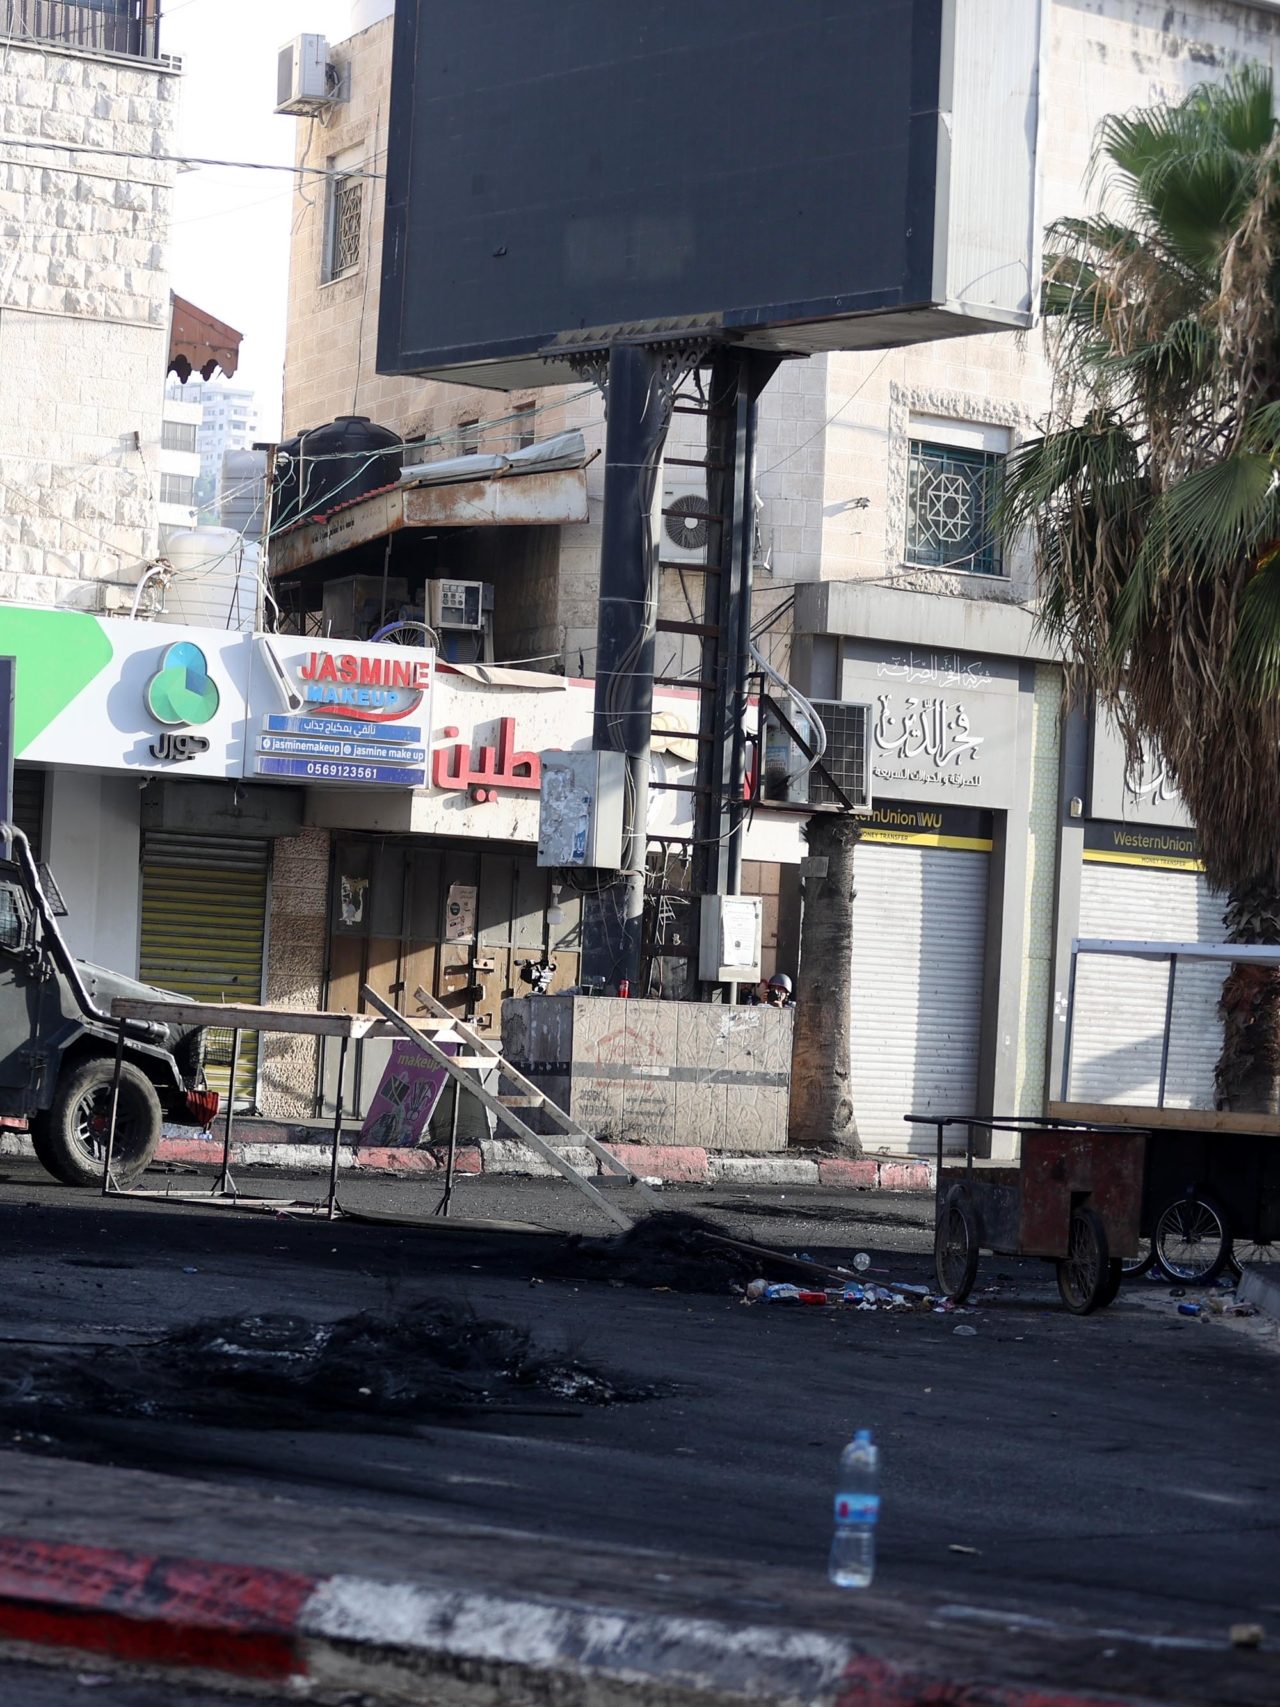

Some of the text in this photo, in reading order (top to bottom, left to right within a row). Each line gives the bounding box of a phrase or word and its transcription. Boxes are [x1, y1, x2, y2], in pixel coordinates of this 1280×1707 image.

[299, 652, 430, 690] JASMINE
[305, 684, 400, 707] MAKEUP
[150, 733, 210, 760] جوال
[271, 739, 424, 761] jasminemakeup jasmine make up
[307, 763, 378, 779] 0569123561
[862, 831, 909, 841] ONEY TRANSFER
[1113, 830, 1193, 852] WesternUnion
